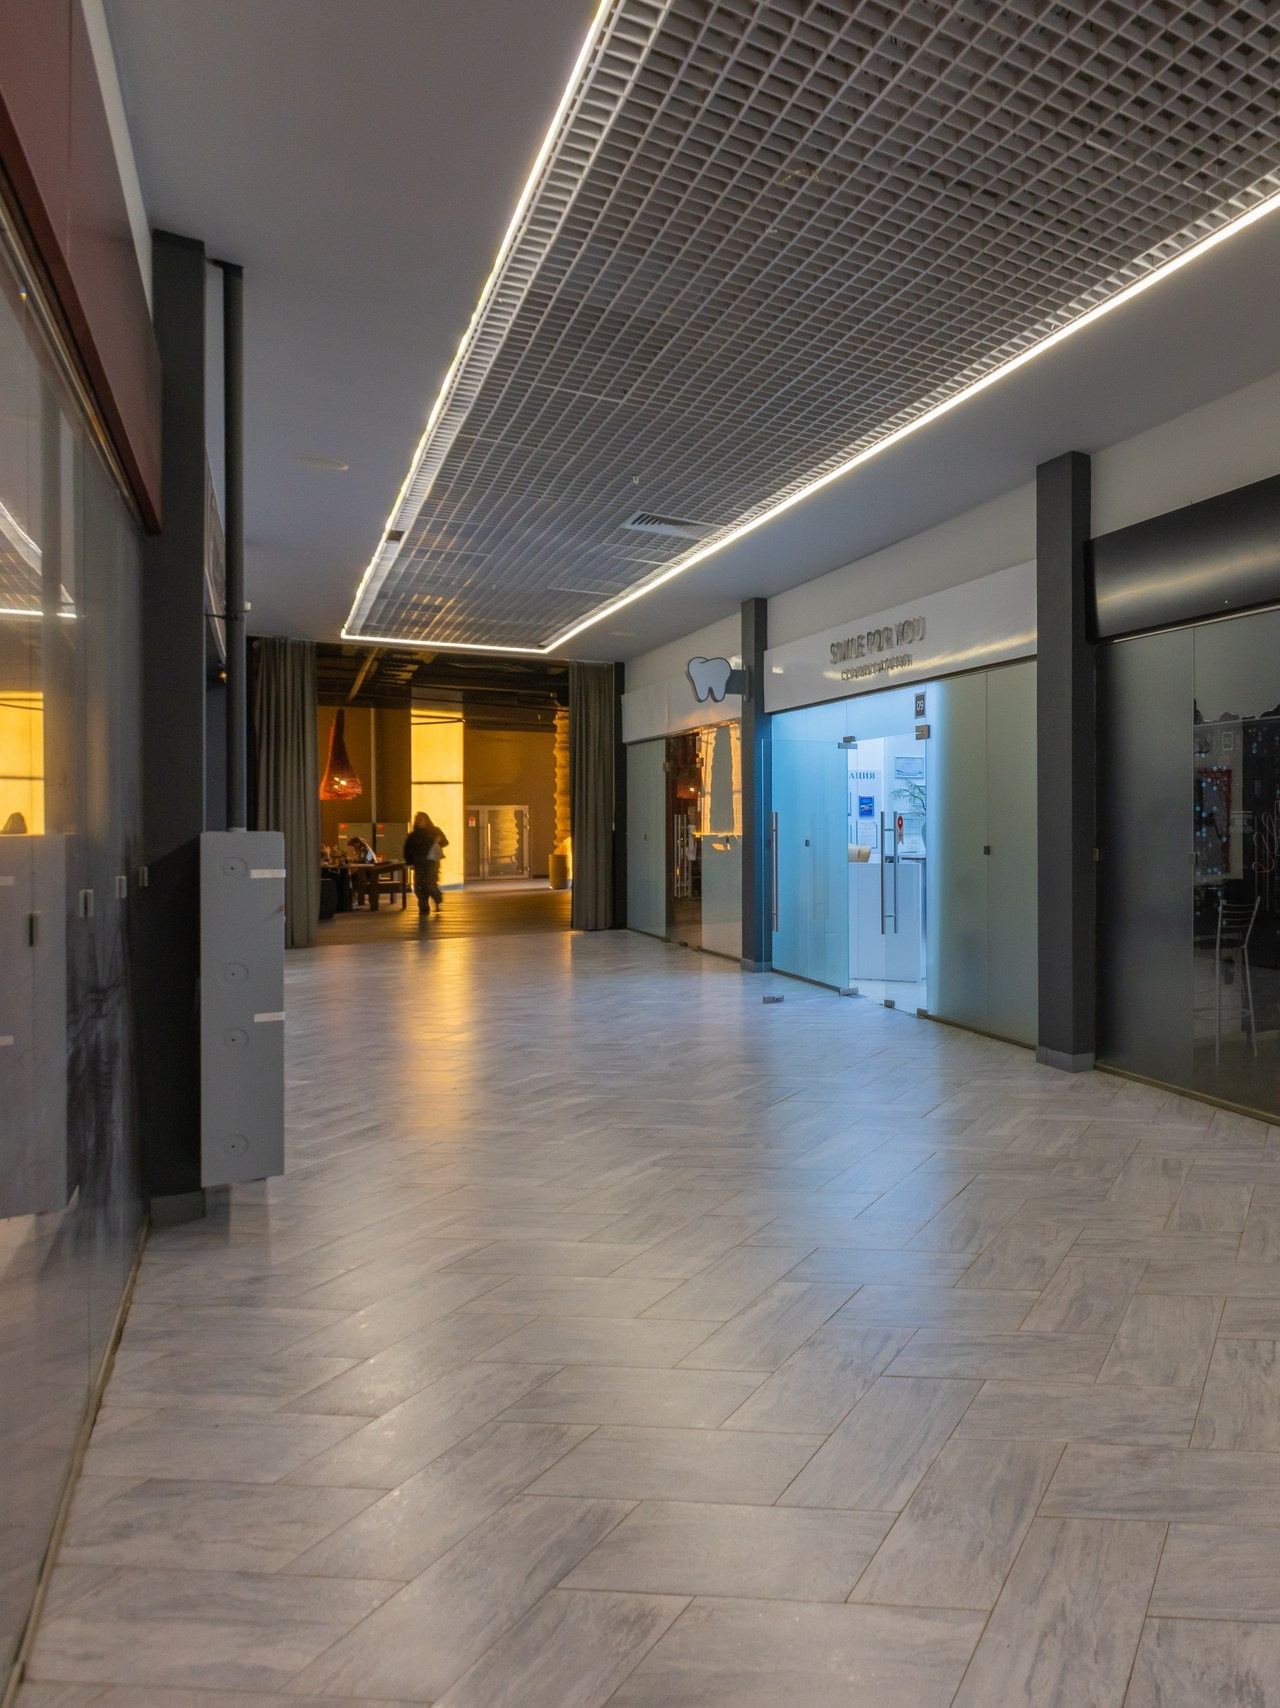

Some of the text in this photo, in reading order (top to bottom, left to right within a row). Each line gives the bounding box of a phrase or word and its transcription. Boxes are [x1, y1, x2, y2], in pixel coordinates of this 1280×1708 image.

[866, 626, 893, 654] FOR
[894, 616, 926, 647] YOU
[916, 699, 924, 711] 09
